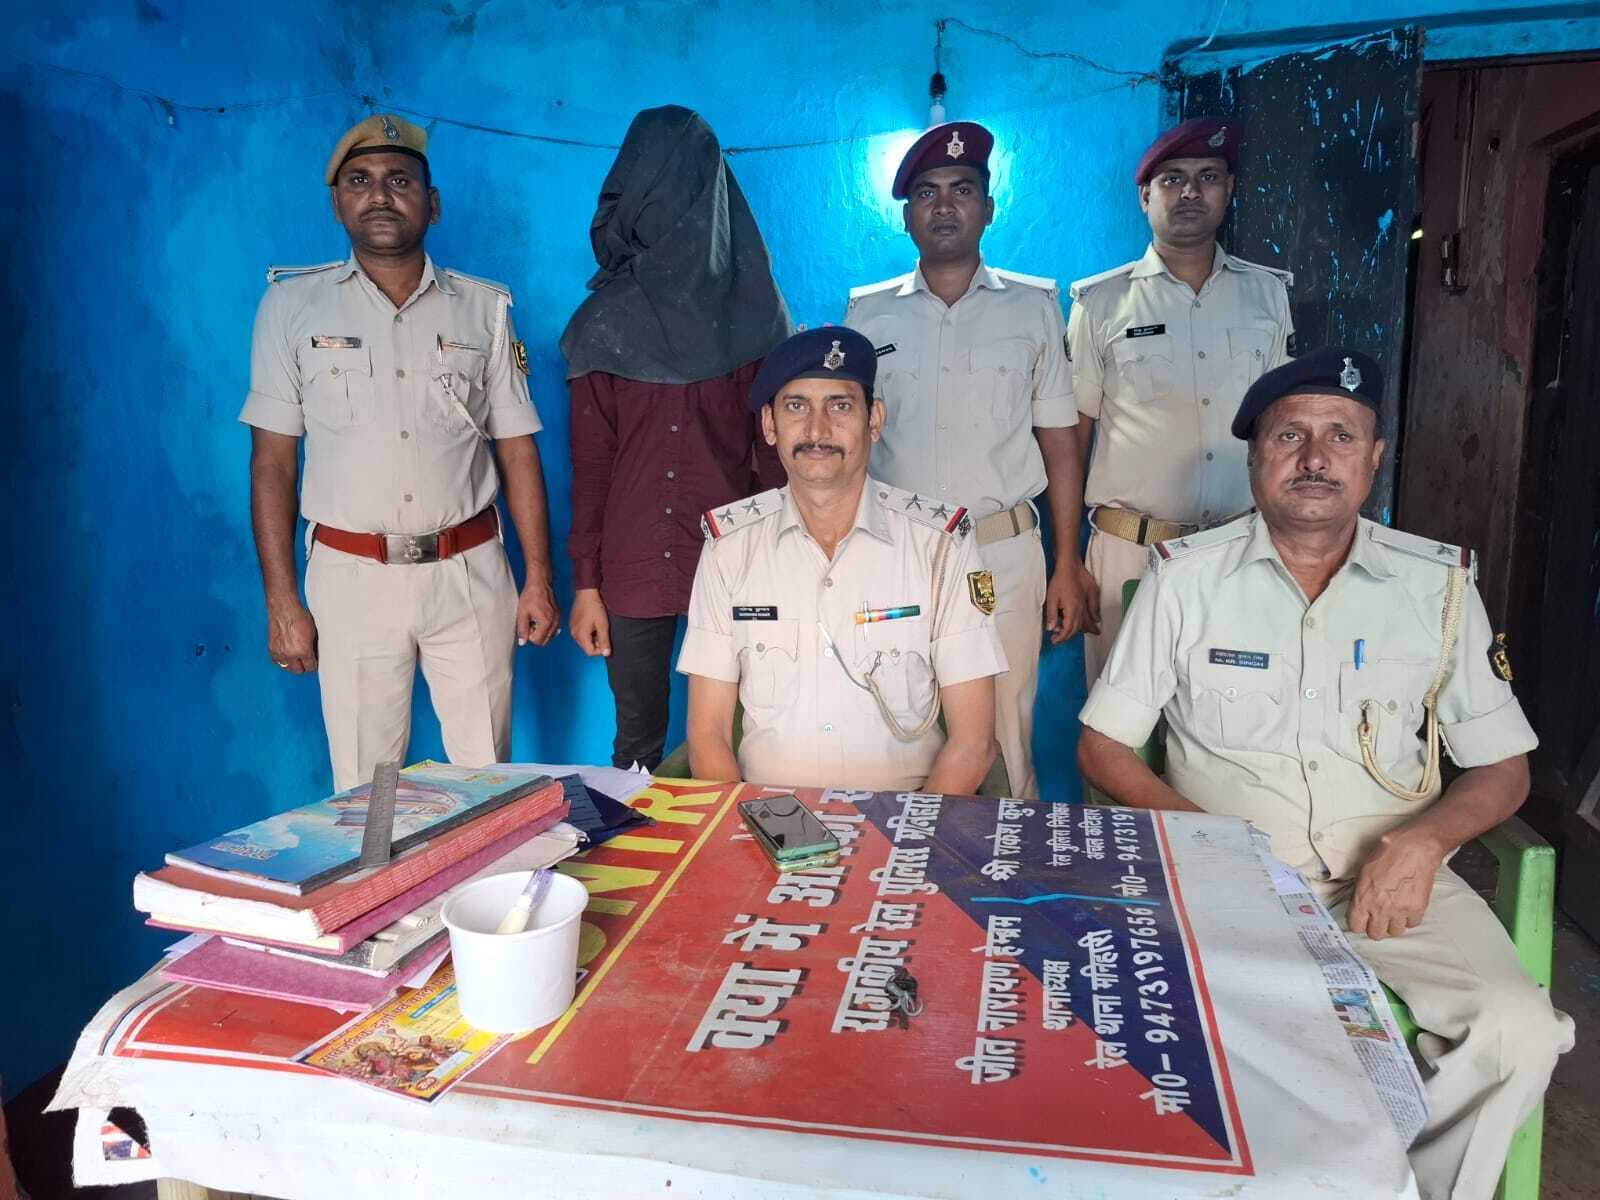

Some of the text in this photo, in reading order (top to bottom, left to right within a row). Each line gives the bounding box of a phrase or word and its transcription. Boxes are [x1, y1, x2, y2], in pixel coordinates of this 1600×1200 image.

[985, 823, 1023, 857] राकेश
[1046, 828, 1080, 853] पुलिस
[1046, 853, 1072, 867] रेल
[981, 860, 1020, 881] श्री
[722, 913, 822, 951] में
[831, 792, 943, 1033] राजकीय रेल पुलिस मनिहारी
[977, 960, 1020, 1032] नारायण
[1042, 959, 1073, 1031] थानाध्यक्ष
[1078, 929, 1128, 1069] रेल थाना मनिहारी
[1126, 907, 1180, 1043] 9473197656
[685, 961, 803, 1052] क्या
[955, 1036, 1017, 1085] जीत
